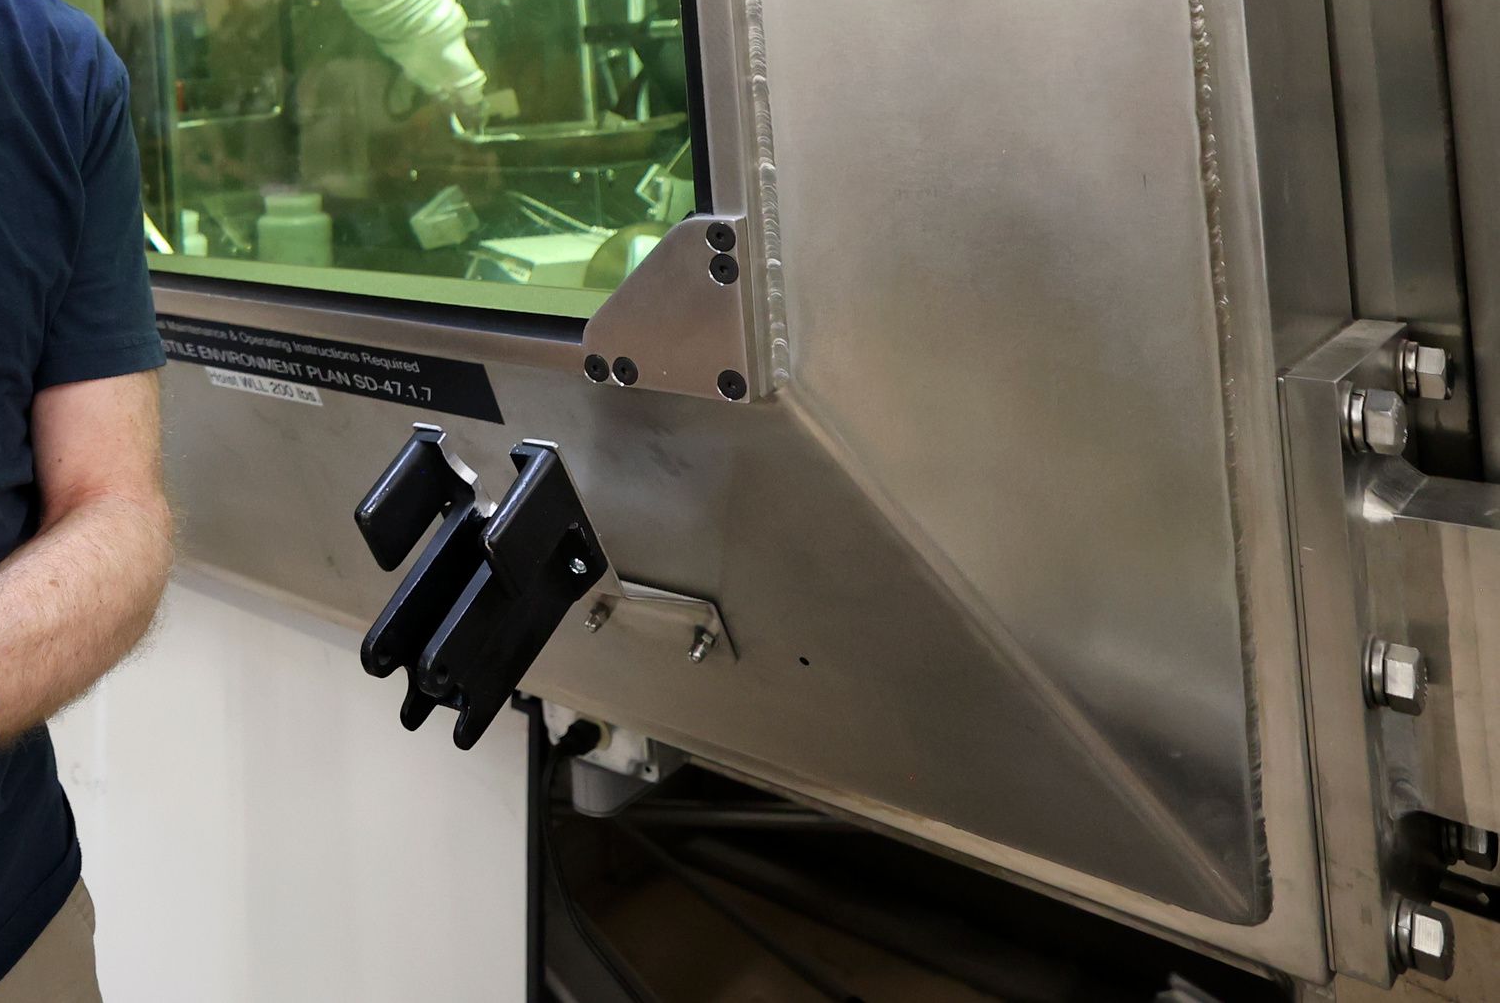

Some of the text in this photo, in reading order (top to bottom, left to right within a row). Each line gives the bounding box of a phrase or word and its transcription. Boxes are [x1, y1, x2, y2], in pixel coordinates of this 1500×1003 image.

[161, 339, 432, 402] STILE ENVIRONMENT PLAN SD-47.1.7
[239, 332, 291, 353] Operating
[293, 340, 360, 363] Instructions
[361, 351, 421, 373] Required
[242, 376, 269, 393] WLL
[270, 381, 294, 398] 200
